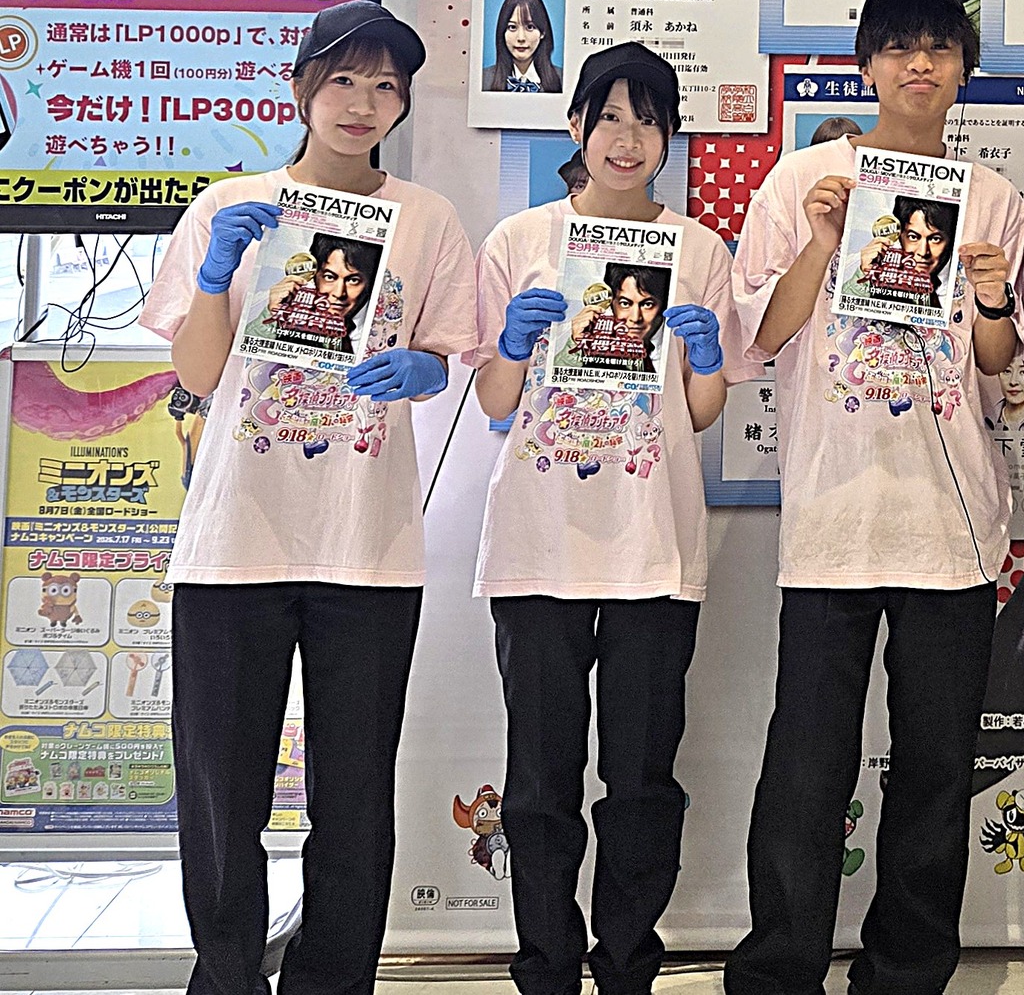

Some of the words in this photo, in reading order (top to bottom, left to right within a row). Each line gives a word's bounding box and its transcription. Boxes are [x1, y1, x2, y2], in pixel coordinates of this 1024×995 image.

[630, 20, 653, 32] 須永
[664, 21, 698, 33] あかね
[580, 37, 614, 46] 生年月日
[861, 154, 965, 183] M-STATION
[278, 187, 393, 224] M-STATION
[569, 222, 677, 247] M-STATION
[838, 303, 855, 312] 9.18
[240, 344, 259, 354] 9.18
[552, 375, 569, 383] 9.18
[864, 387, 892, 401] 9.18
[277, 428, 308, 442] 9.18
[70, 446, 129, 458] ILLUMINATION'S
[554, 449, 581, 463] 9.18
[38, 458, 160, 487] ミニオンズ
[46, 485, 149, 505] &モンスターズ
[10, 532, 93, 543] ナムコキャンペーン
[28, 549, 172, 572] ナムコ限定プライ
[63, 721, 172, 740] ナムコ限定特典
[448, 899, 464, 907] NOT
[464, 899, 478, 907] FOR
[479, 899, 496, 907] SALE
